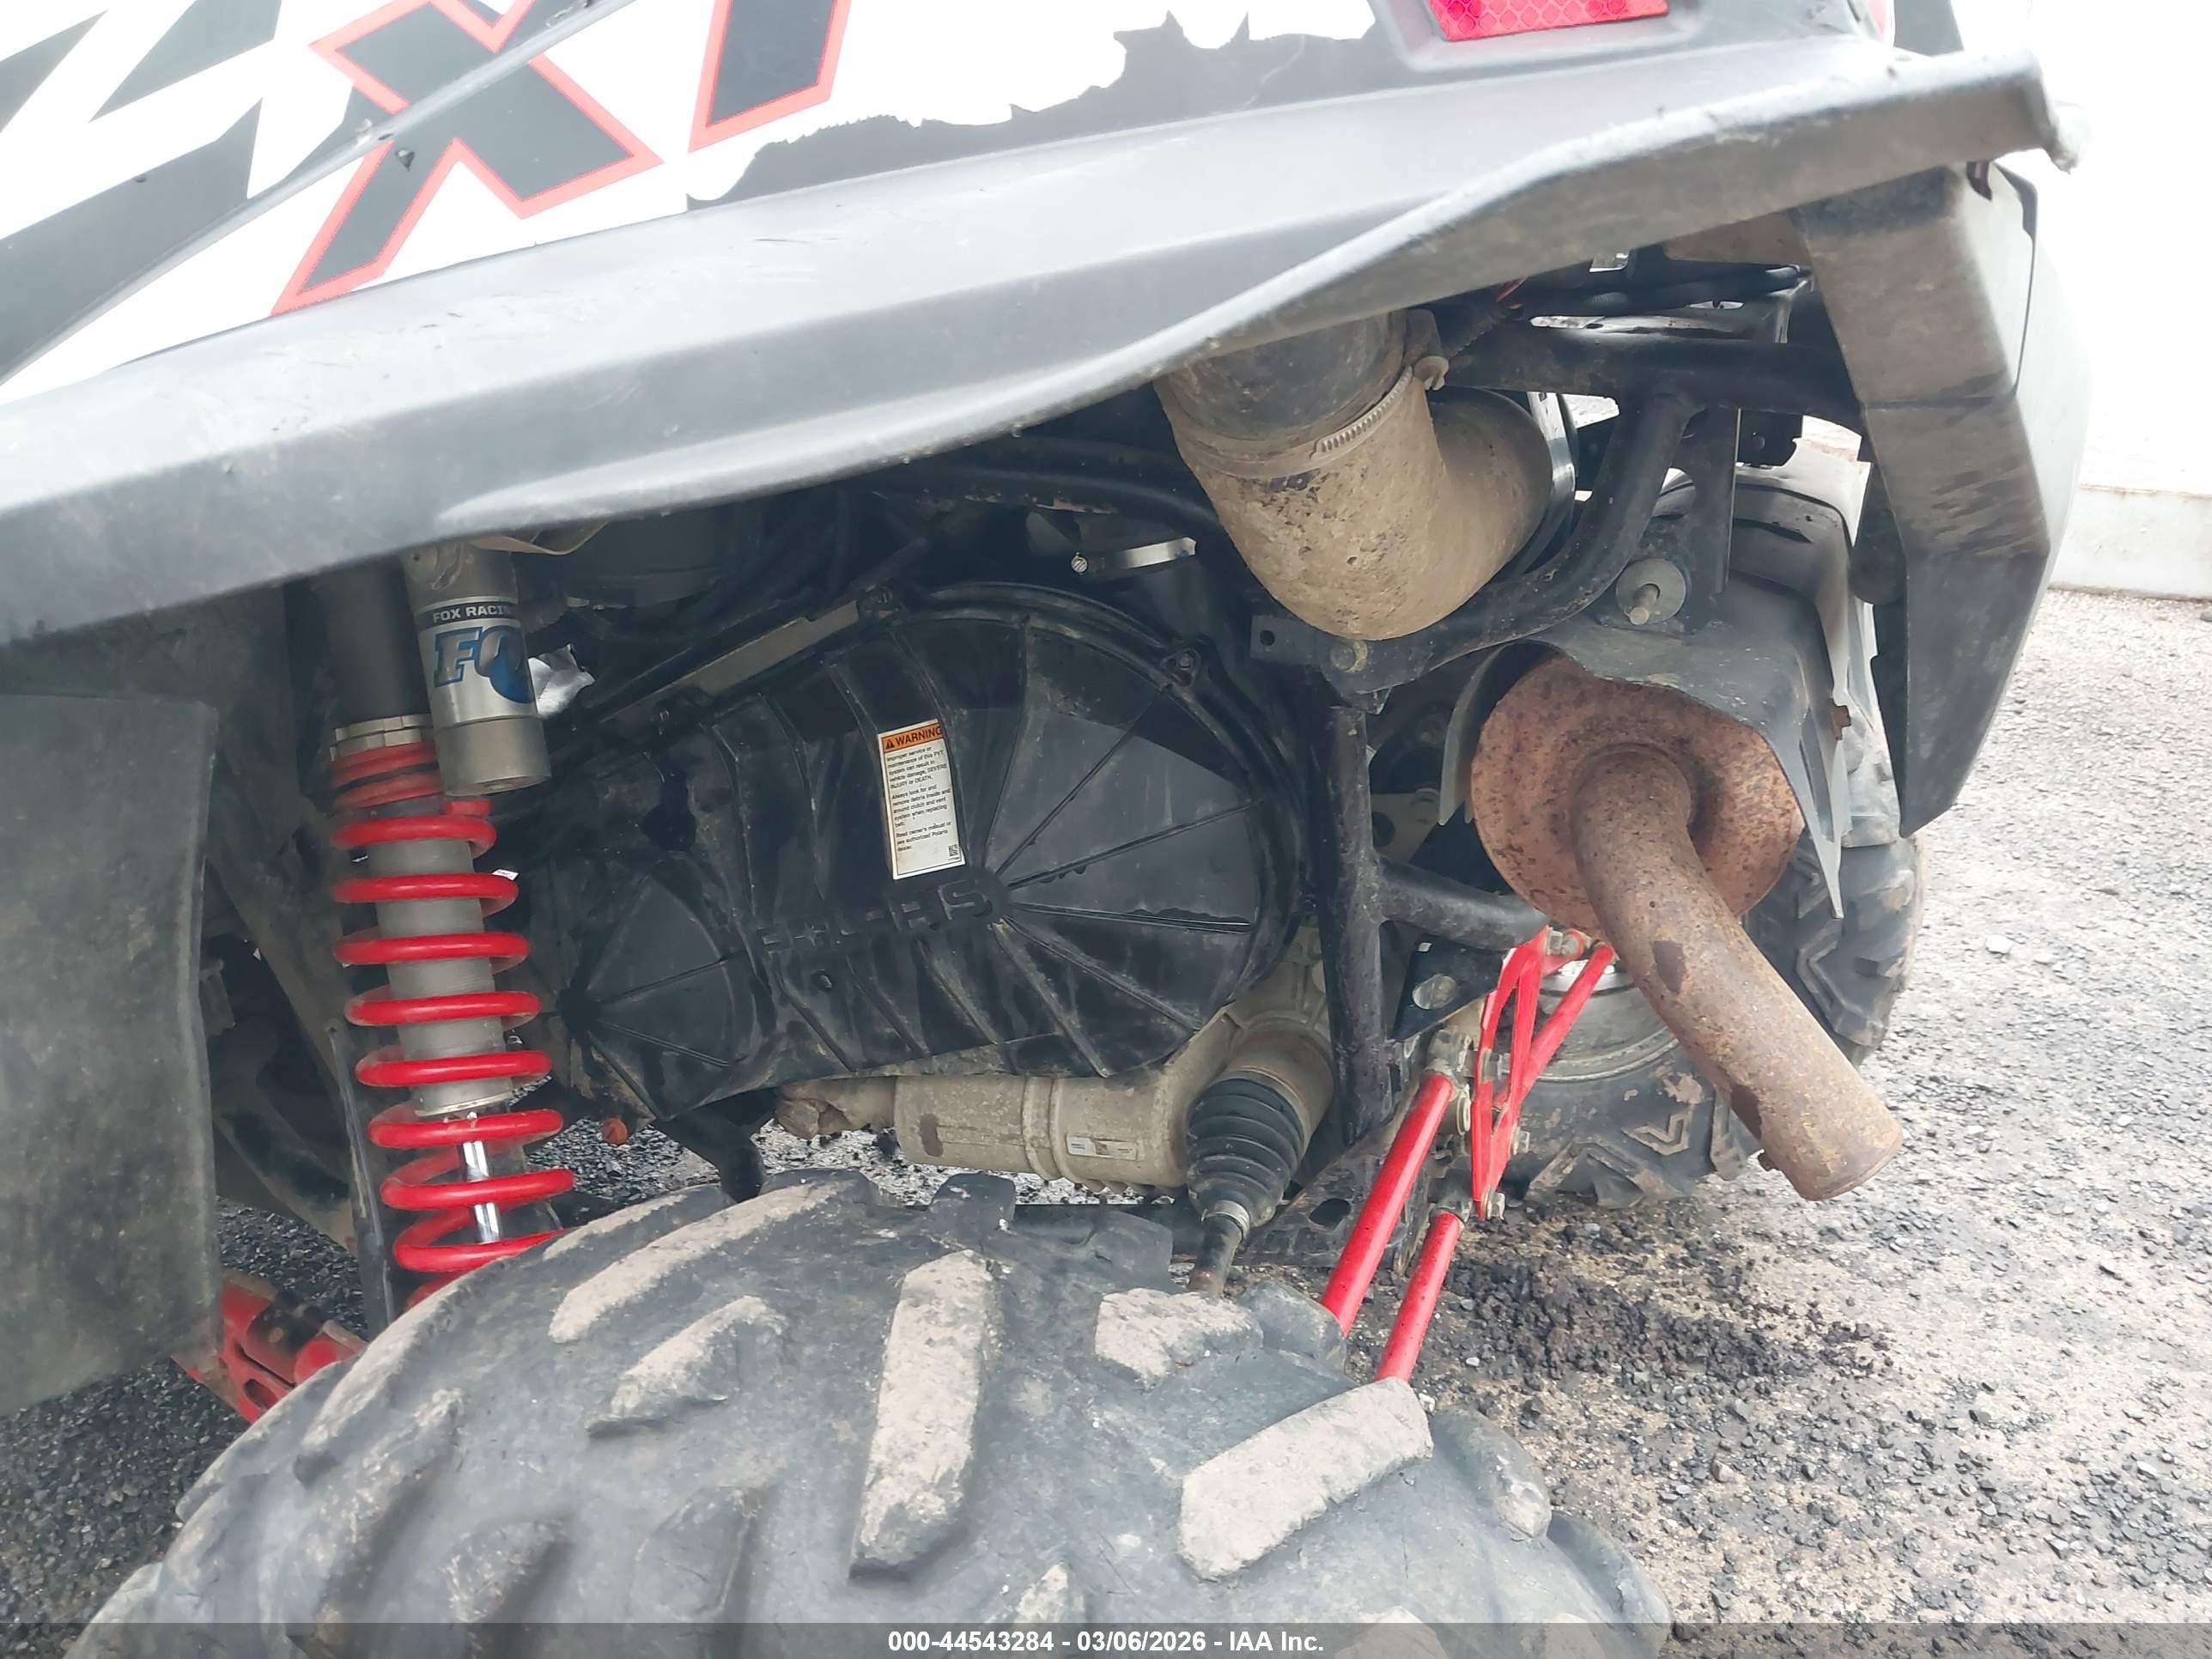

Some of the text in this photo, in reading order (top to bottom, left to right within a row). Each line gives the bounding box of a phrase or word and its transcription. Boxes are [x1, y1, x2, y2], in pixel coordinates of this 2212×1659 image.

[433, 608, 461, 623] FOX
[433, 624, 534, 704] FO
[895, 726, 943, 746] WARNING
